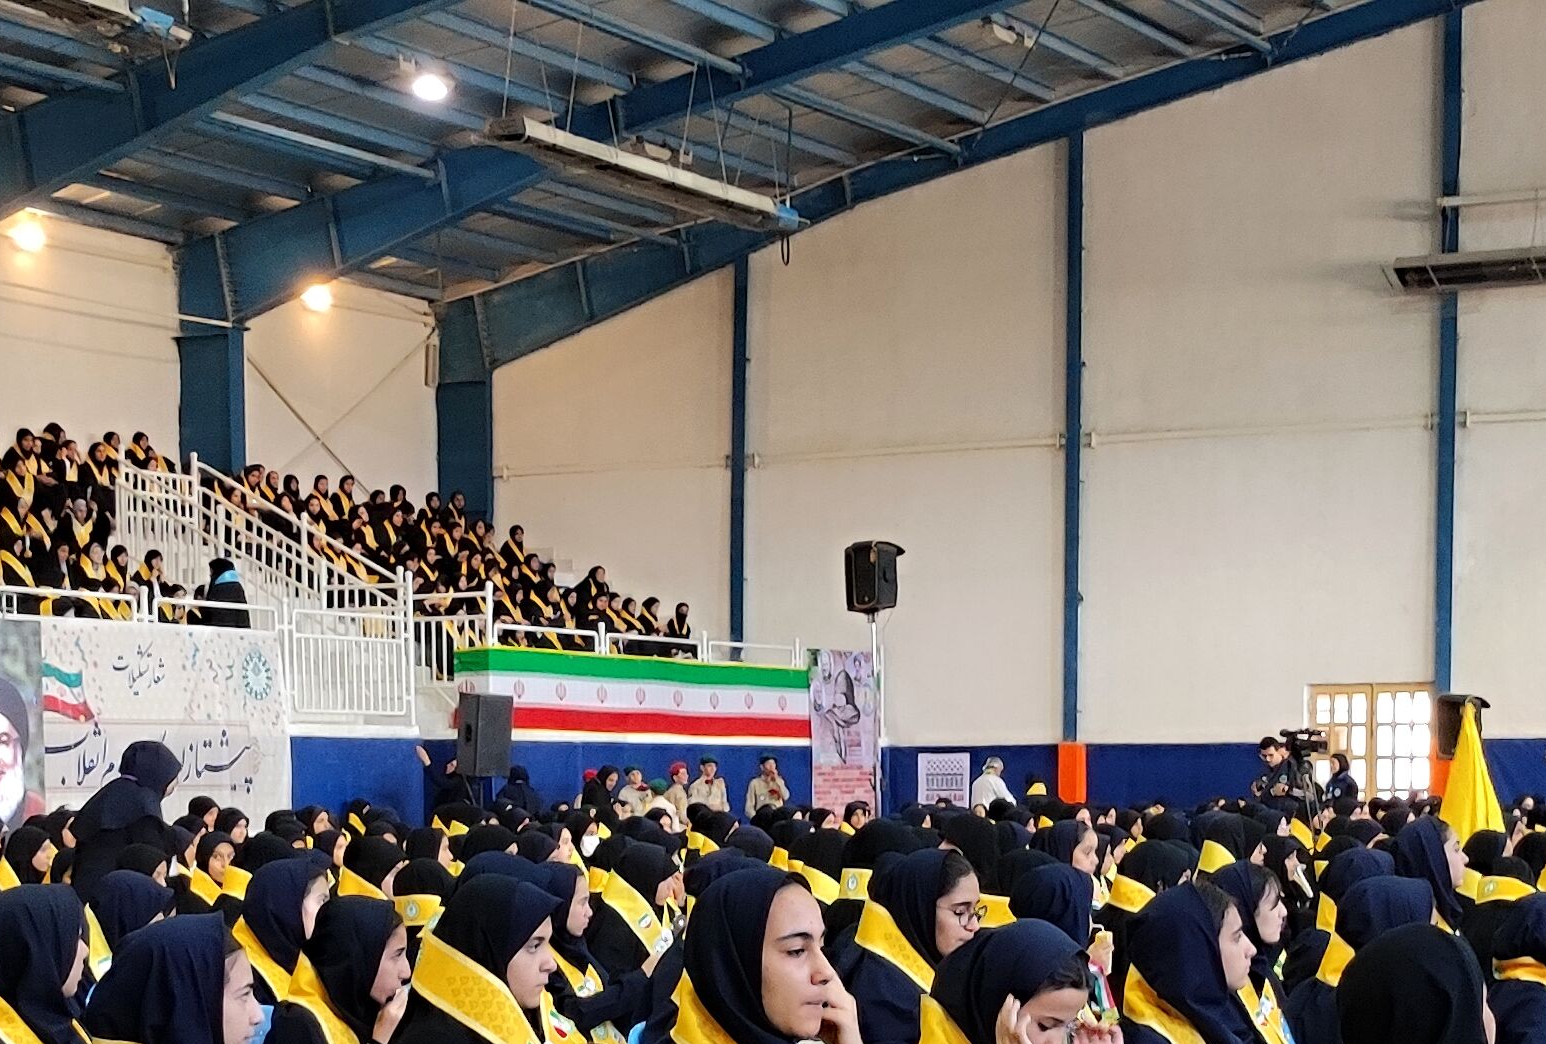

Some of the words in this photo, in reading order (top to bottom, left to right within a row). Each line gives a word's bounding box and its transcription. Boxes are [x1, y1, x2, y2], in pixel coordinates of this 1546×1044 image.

[112, 640, 153, 696] تشکیلات
[45, 721, 108, 786] انقلاب
[181, 729, 253, 794] پیشتازا
